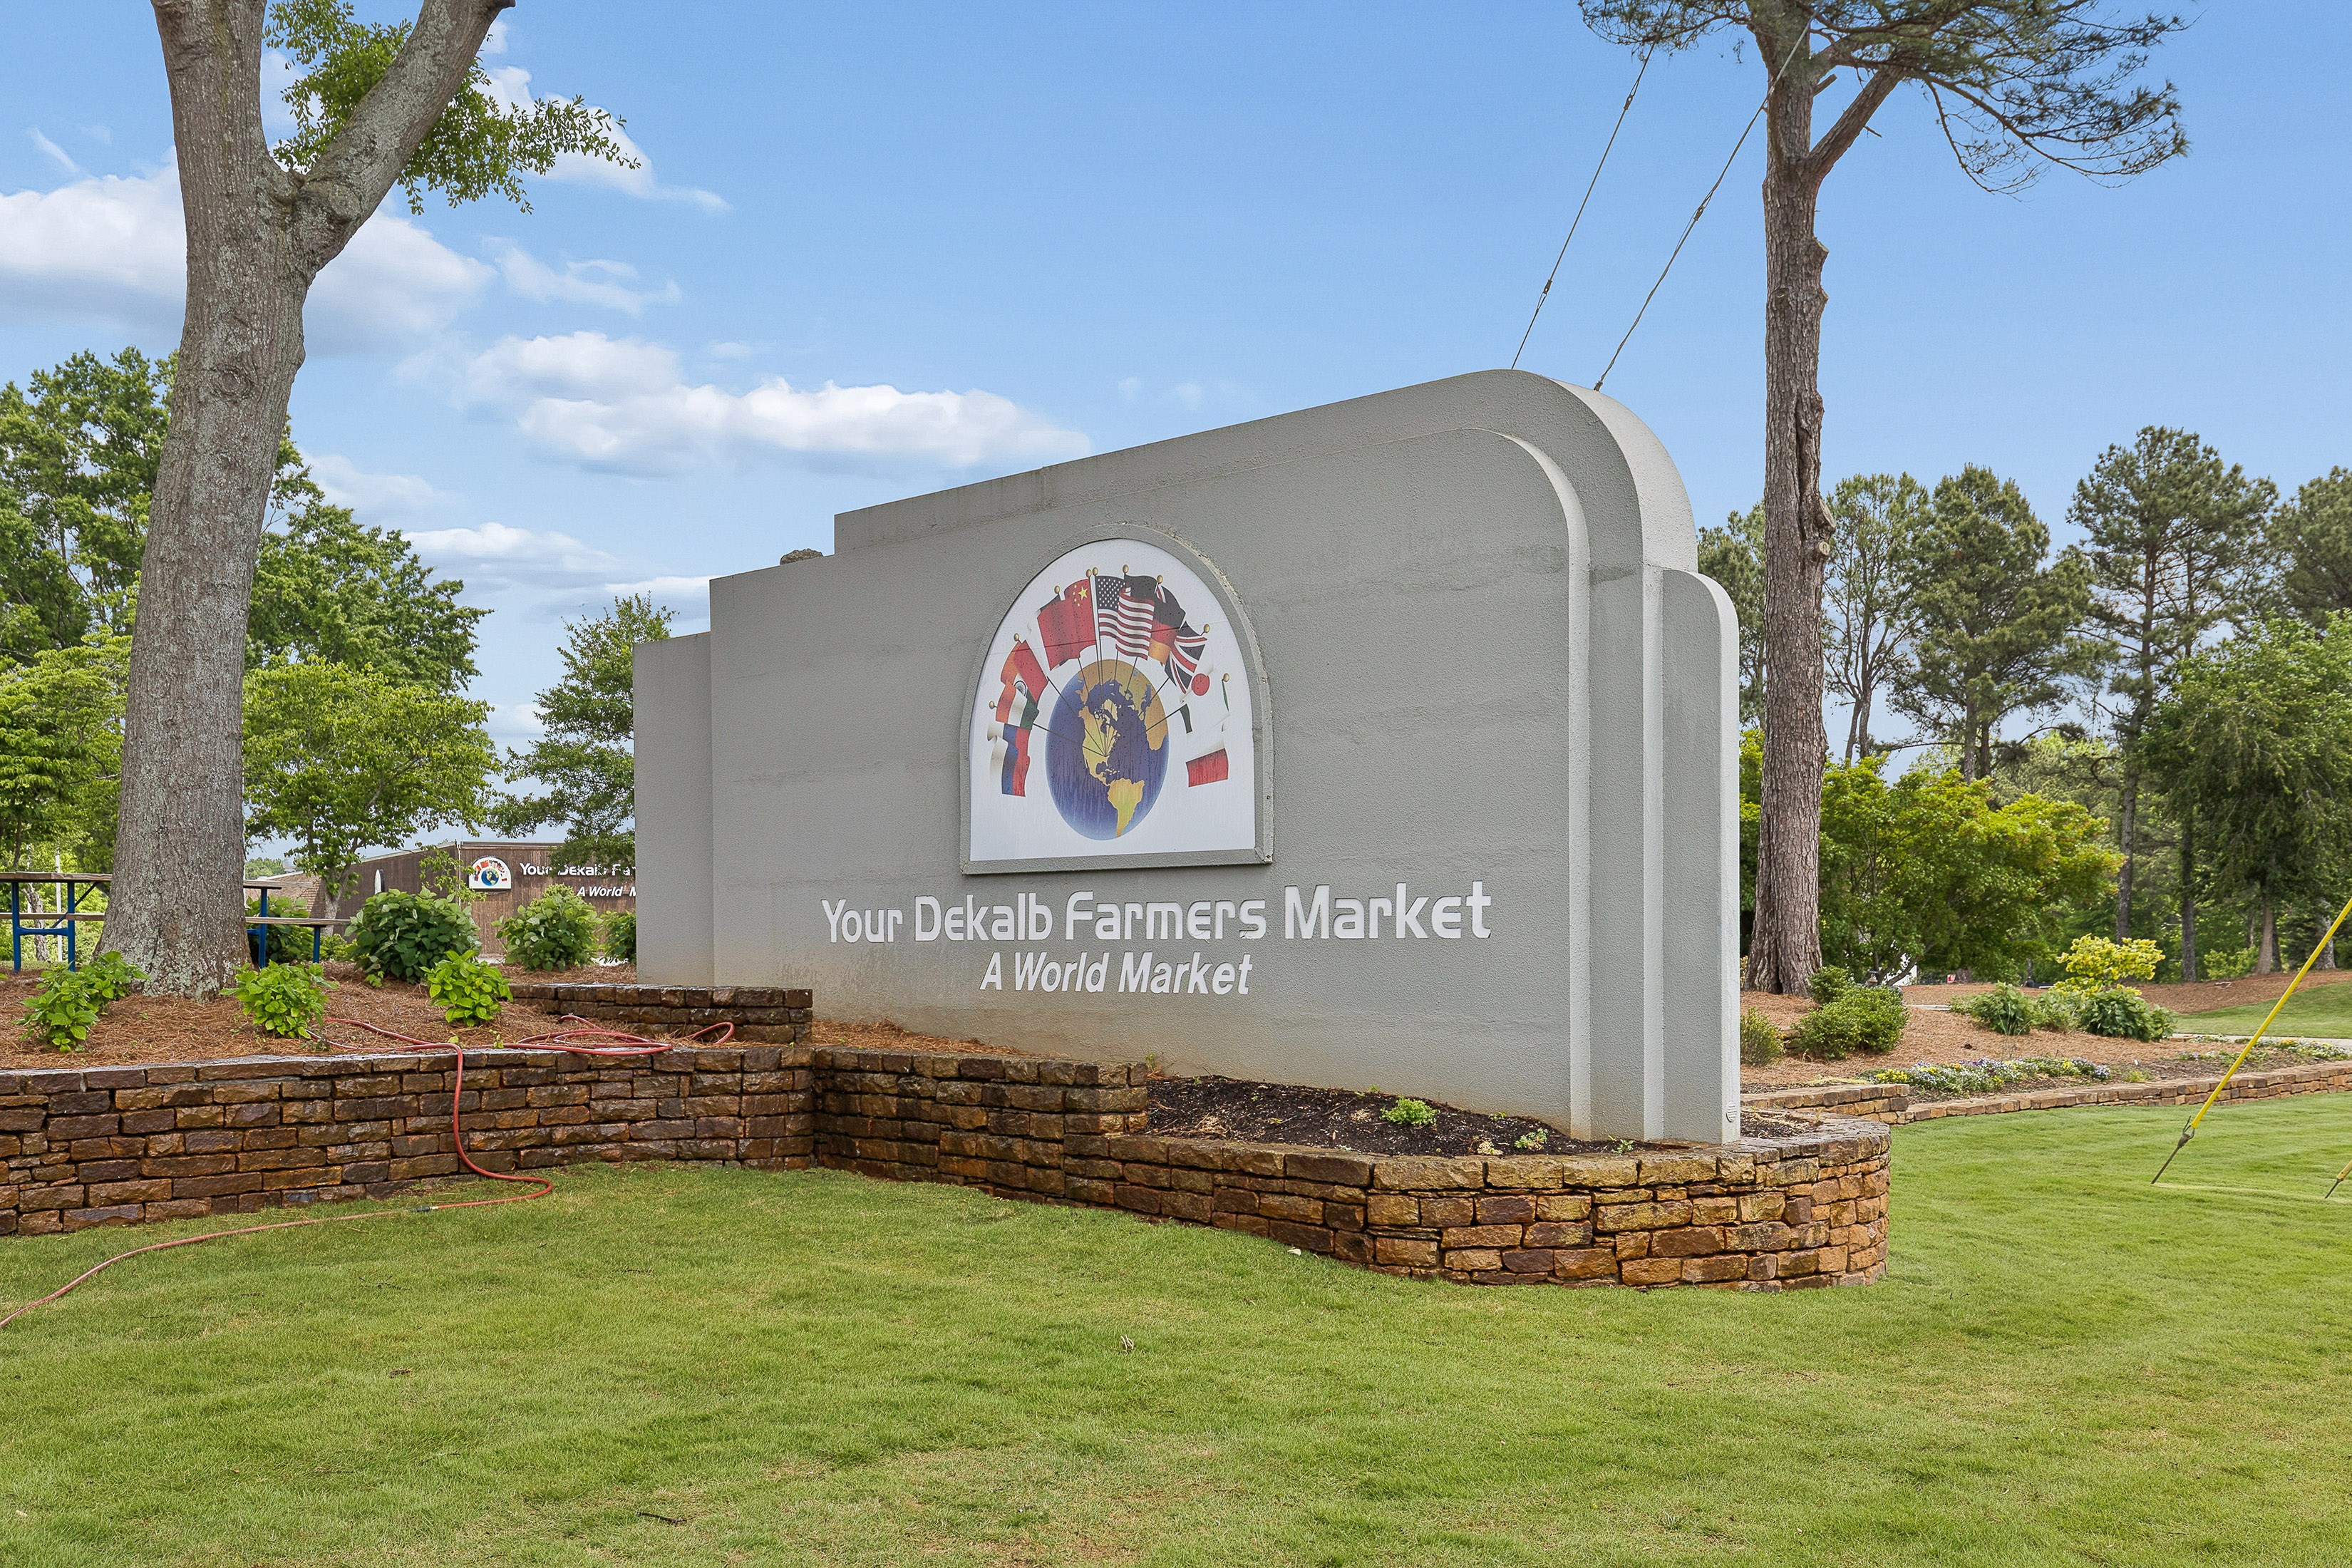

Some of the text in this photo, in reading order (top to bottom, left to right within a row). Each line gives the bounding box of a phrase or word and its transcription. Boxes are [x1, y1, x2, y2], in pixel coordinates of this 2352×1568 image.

[576, 886, 586, 897] A
[589, 886, 624, 897] World
[821, 880, 1492, 942] Your Dekalb Farmers Market
[979, 951, 1254, 995] A World Market
